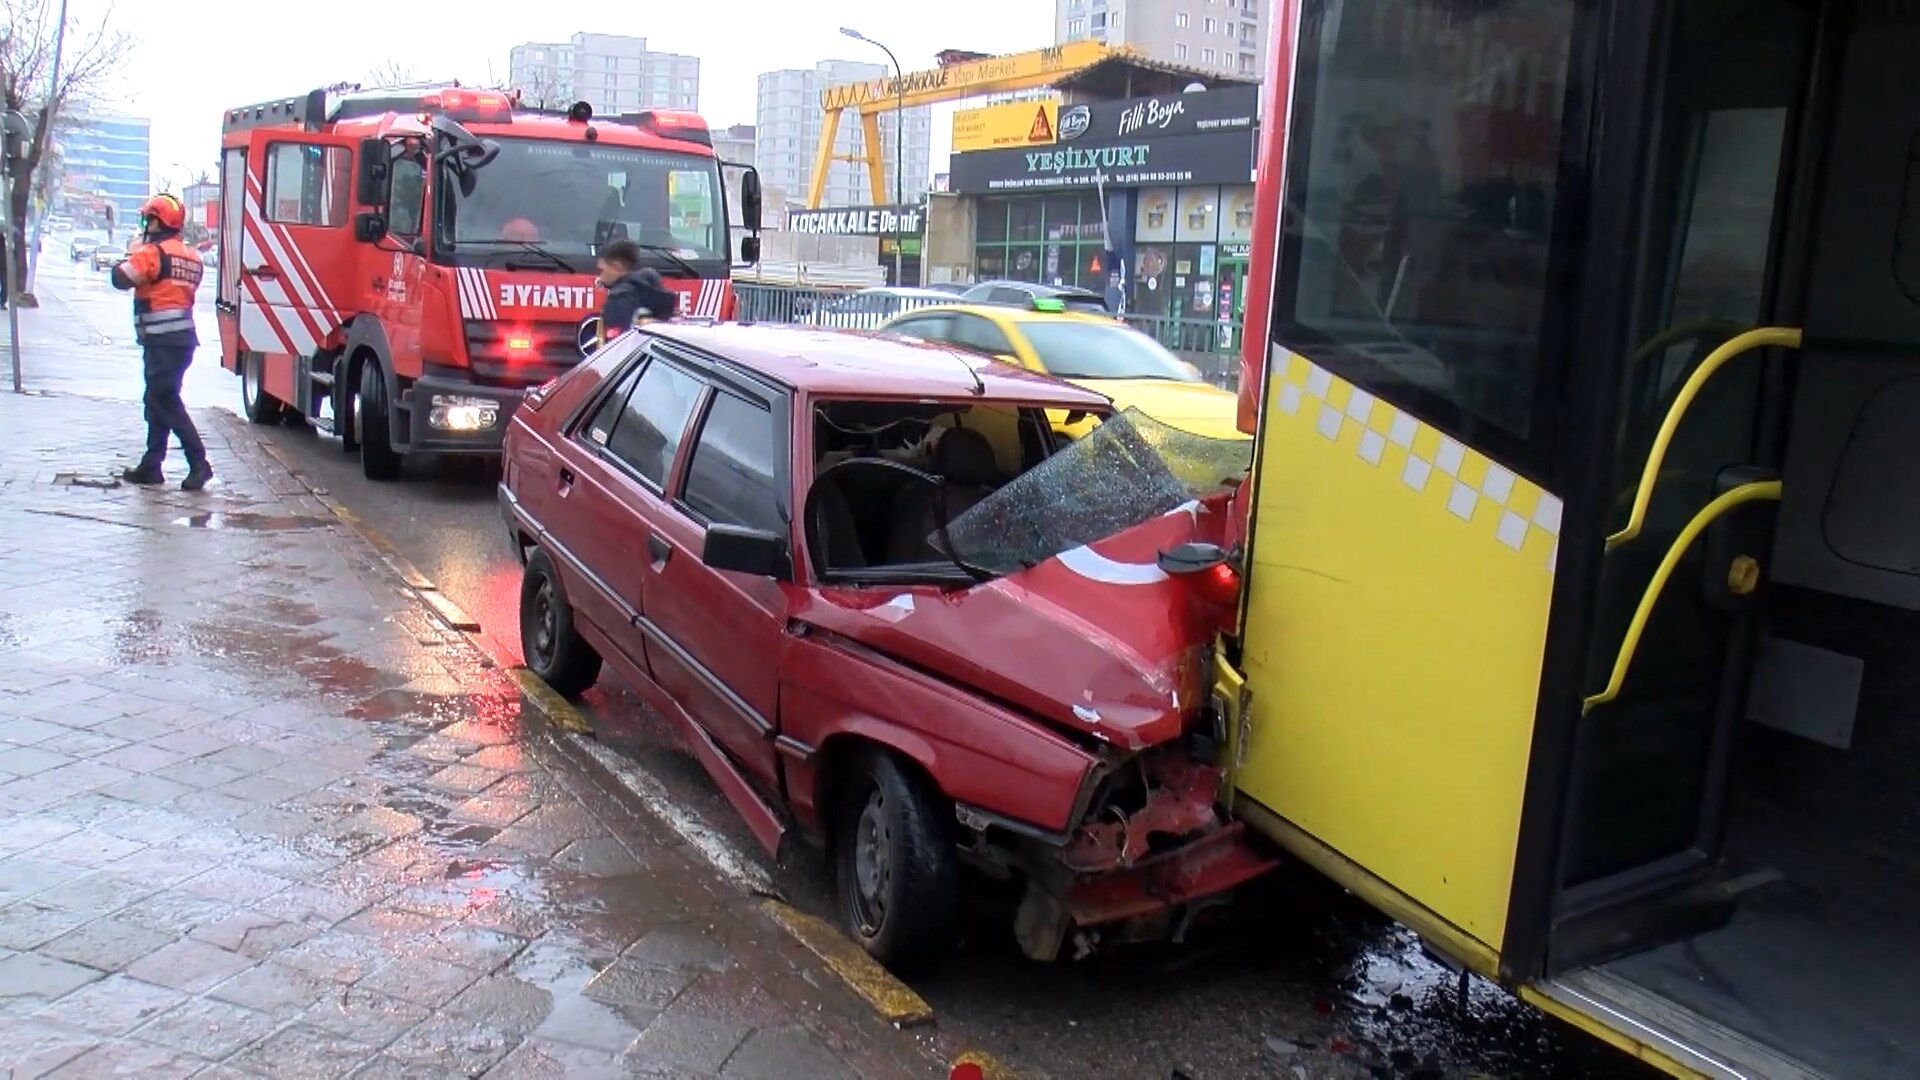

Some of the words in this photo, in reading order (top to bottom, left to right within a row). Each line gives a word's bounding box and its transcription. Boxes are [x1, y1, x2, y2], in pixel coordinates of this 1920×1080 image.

[978, 62, 1016, 80] Market
[1118, 102, 1145, 136] Filli
[1147, 99, 1184, 128] Boya
[1026, 145, 1150, 174] YEŞİLYURT
